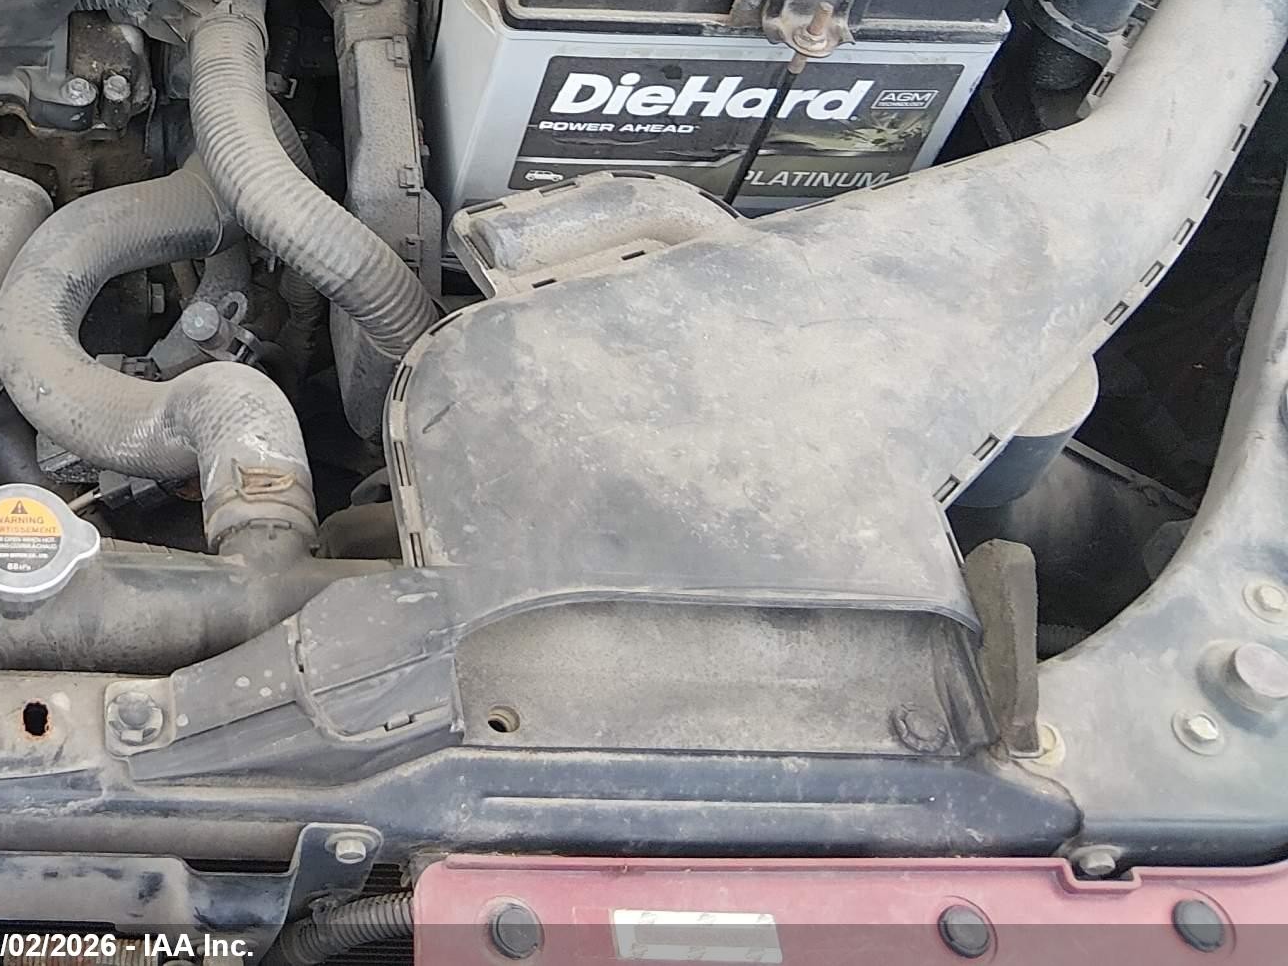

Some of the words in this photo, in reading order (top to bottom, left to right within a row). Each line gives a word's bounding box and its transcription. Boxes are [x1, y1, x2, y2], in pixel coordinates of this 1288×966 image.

[550, 72, 874, 121] DieHard
[880, 92, 932, 102] AGM
[538, 120, 615, 132] POWER
